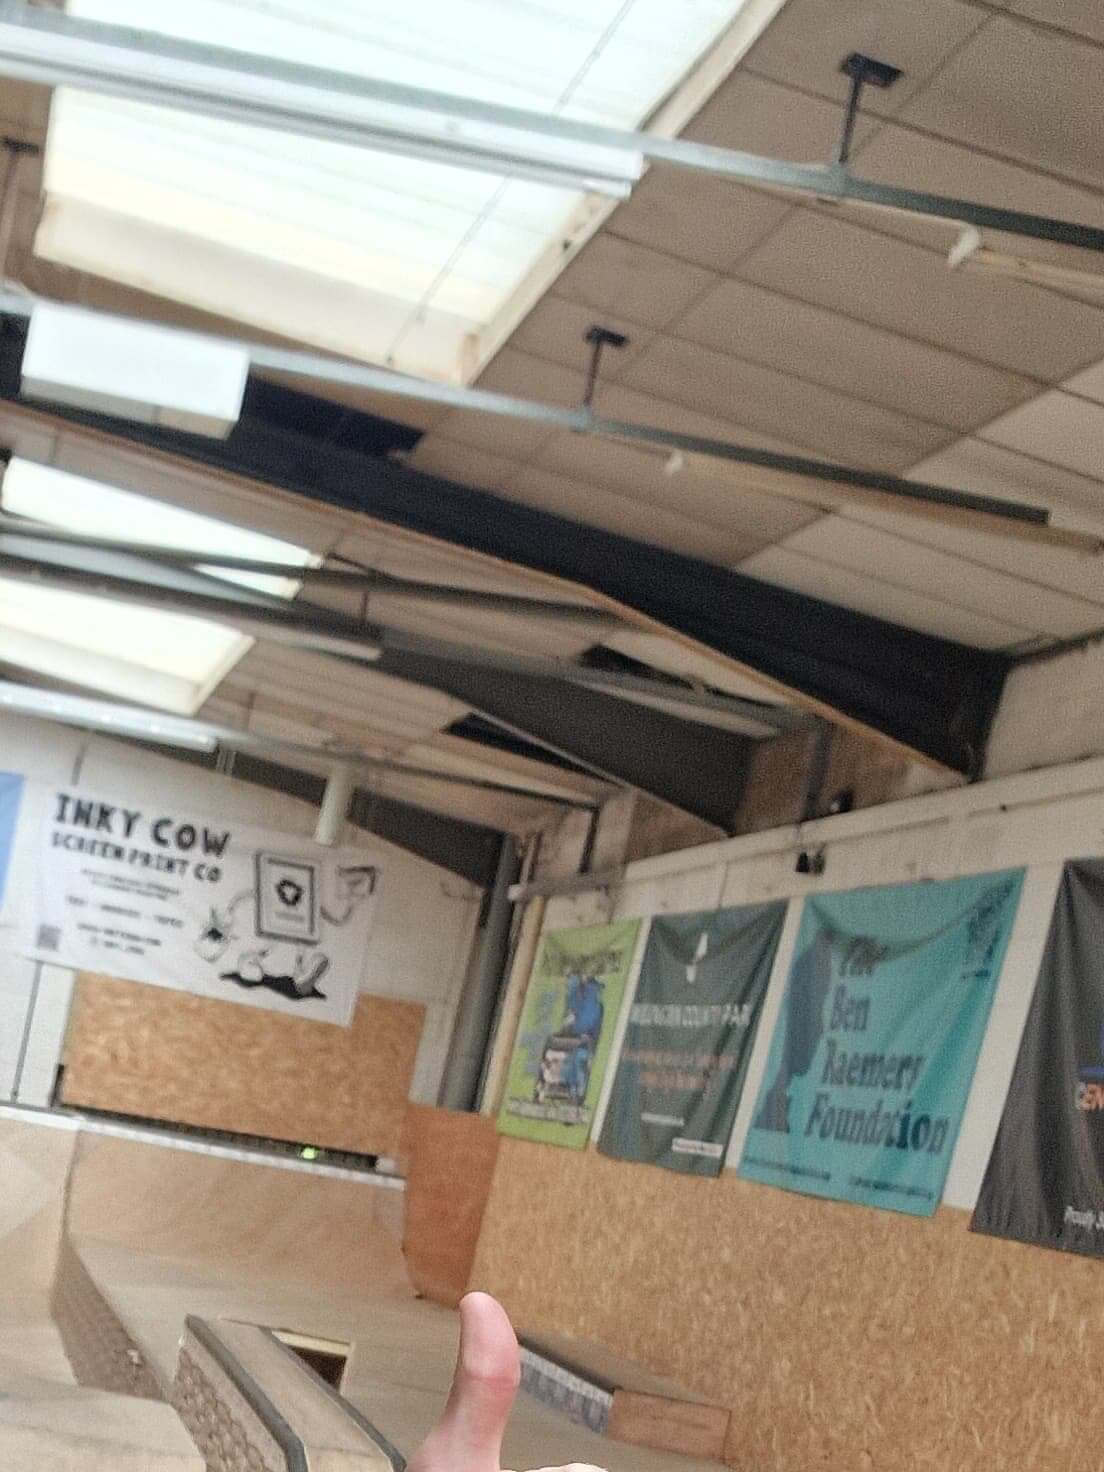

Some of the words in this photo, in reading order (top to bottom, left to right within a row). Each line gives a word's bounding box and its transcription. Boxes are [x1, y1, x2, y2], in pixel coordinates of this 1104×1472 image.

[55, 793, 141, 838] INKY
[152, 817, 231, 859] COW
[803, 1091, 951, 1153] Foundation
